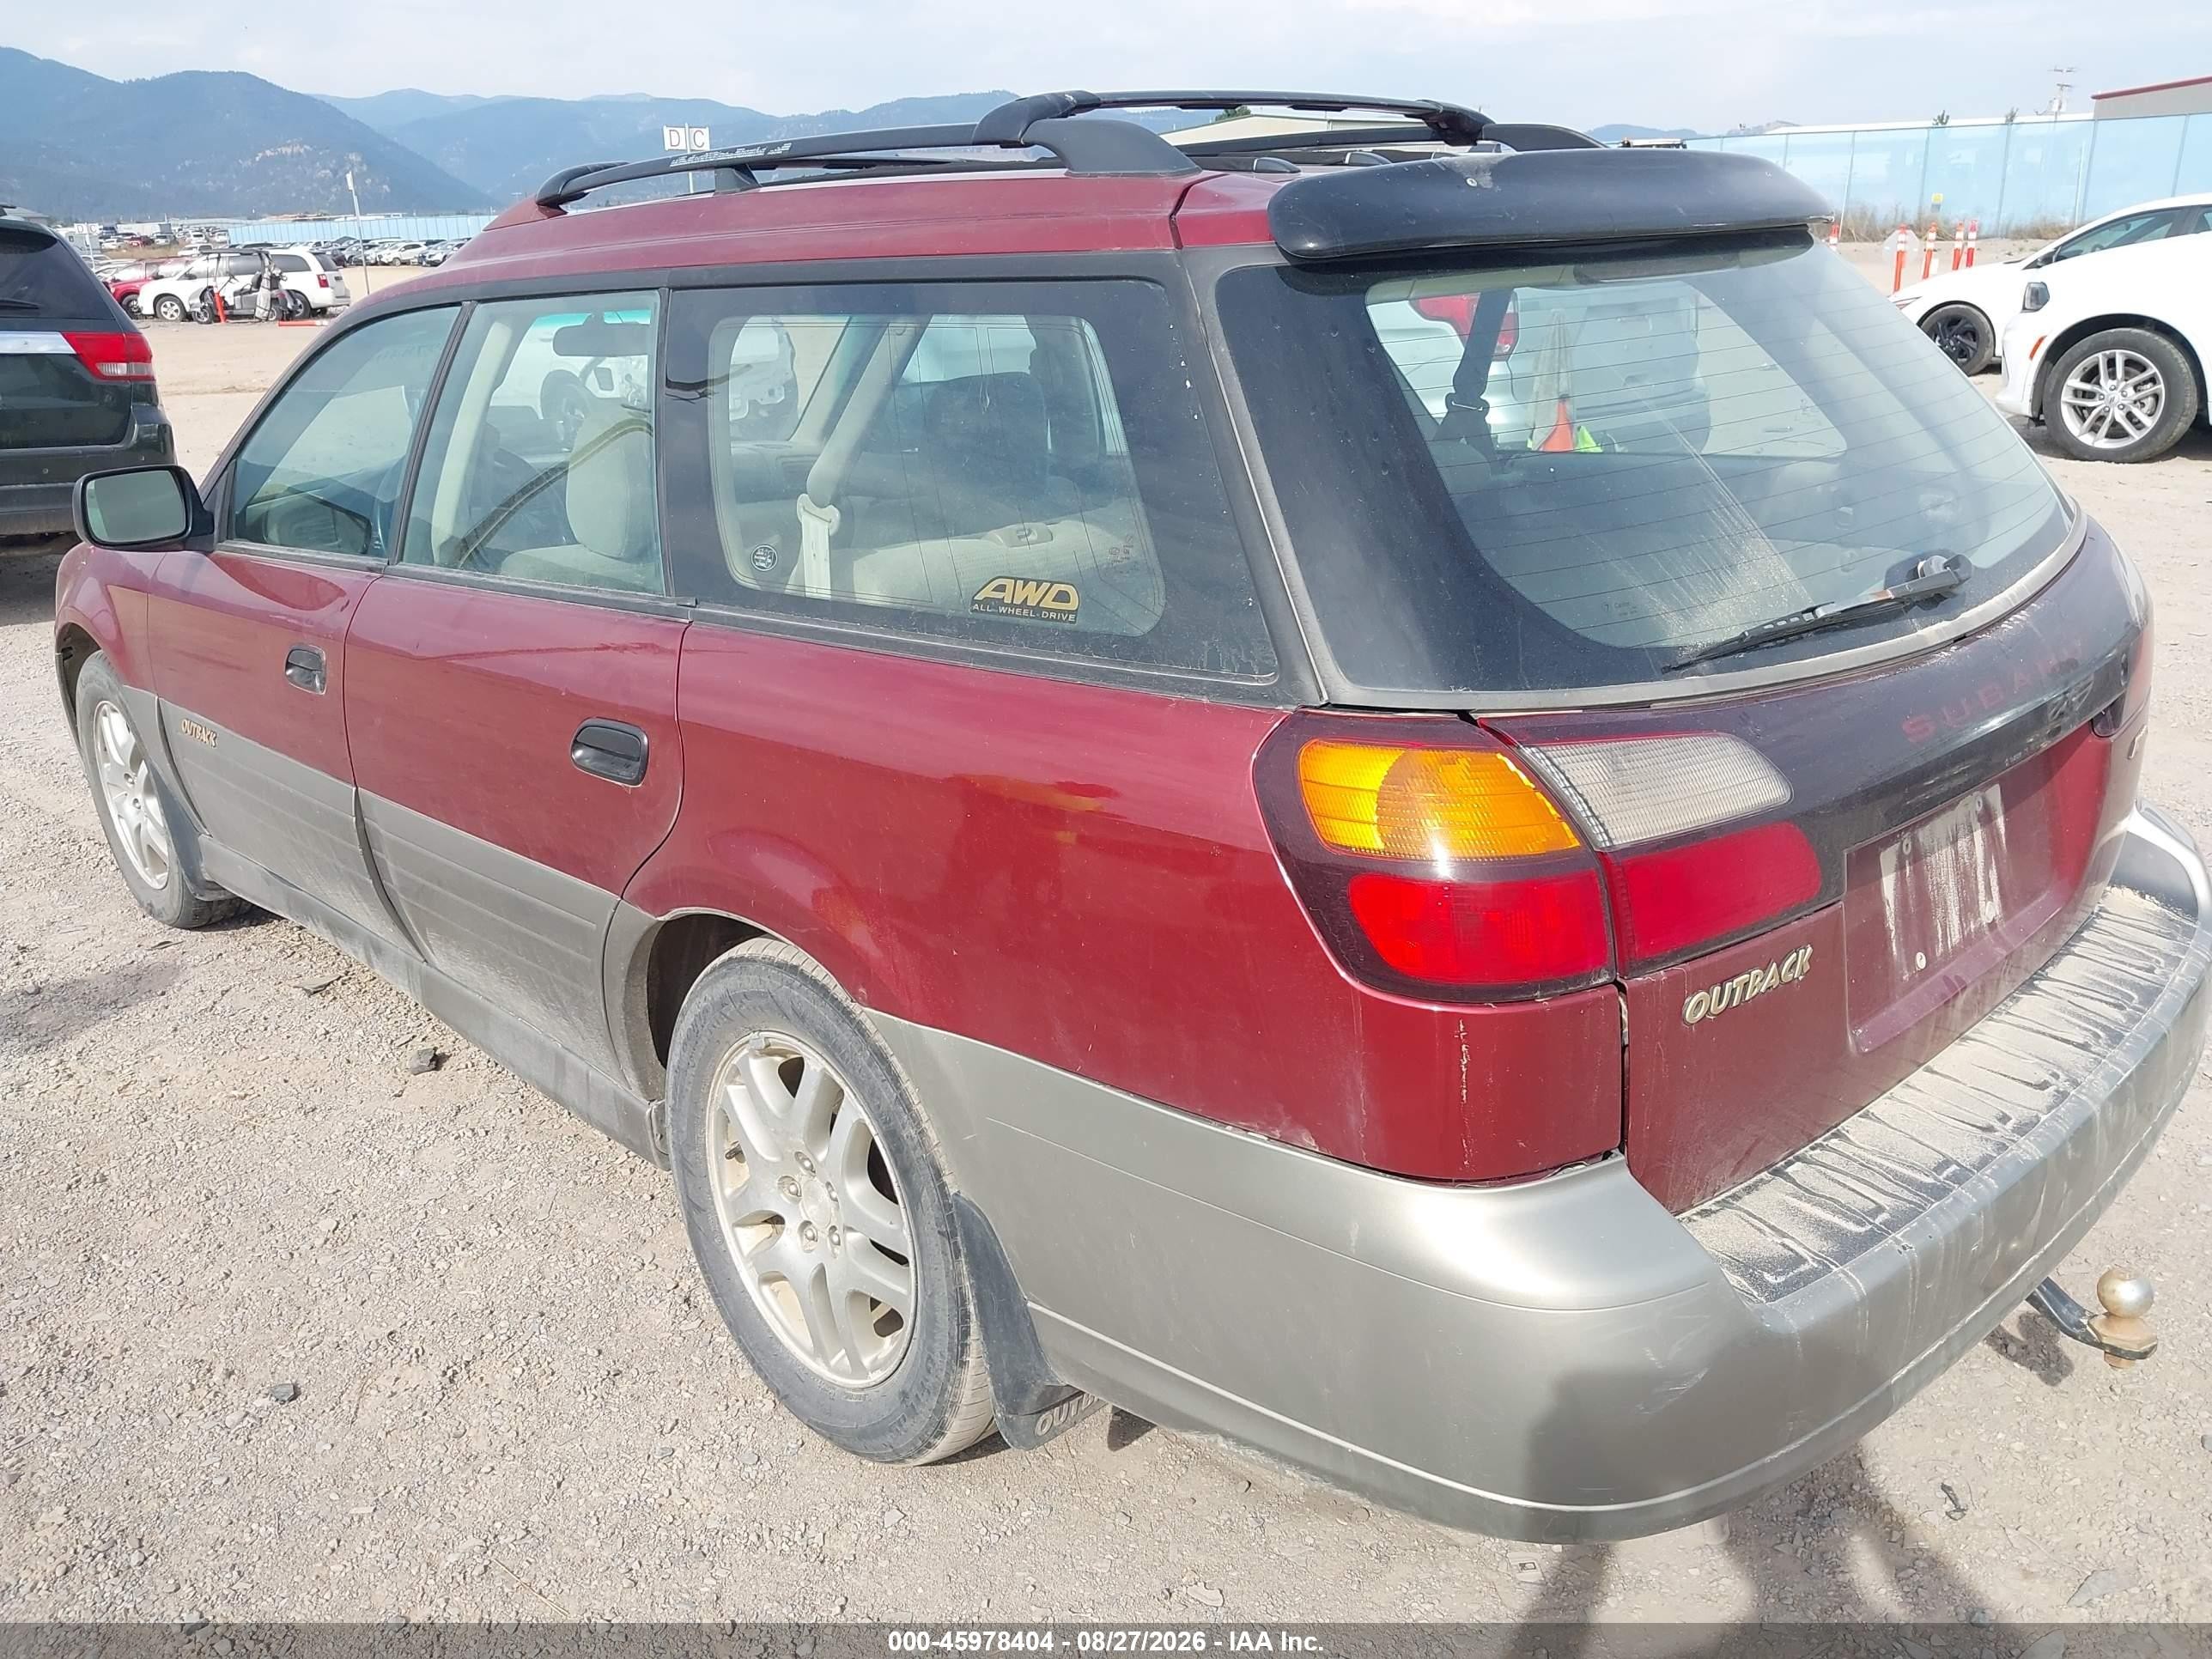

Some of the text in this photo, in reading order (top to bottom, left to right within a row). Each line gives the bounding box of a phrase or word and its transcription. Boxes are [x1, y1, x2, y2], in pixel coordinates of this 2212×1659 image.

[668, 129, 681, 148] D
[693, 130, 705, 148] C
[973, 577, 1079, 611] AWD
[972, 603, 1077, 622] ALL WHEEL DRIVE
[1682, 944, 1814, 1025] OUTBACK
